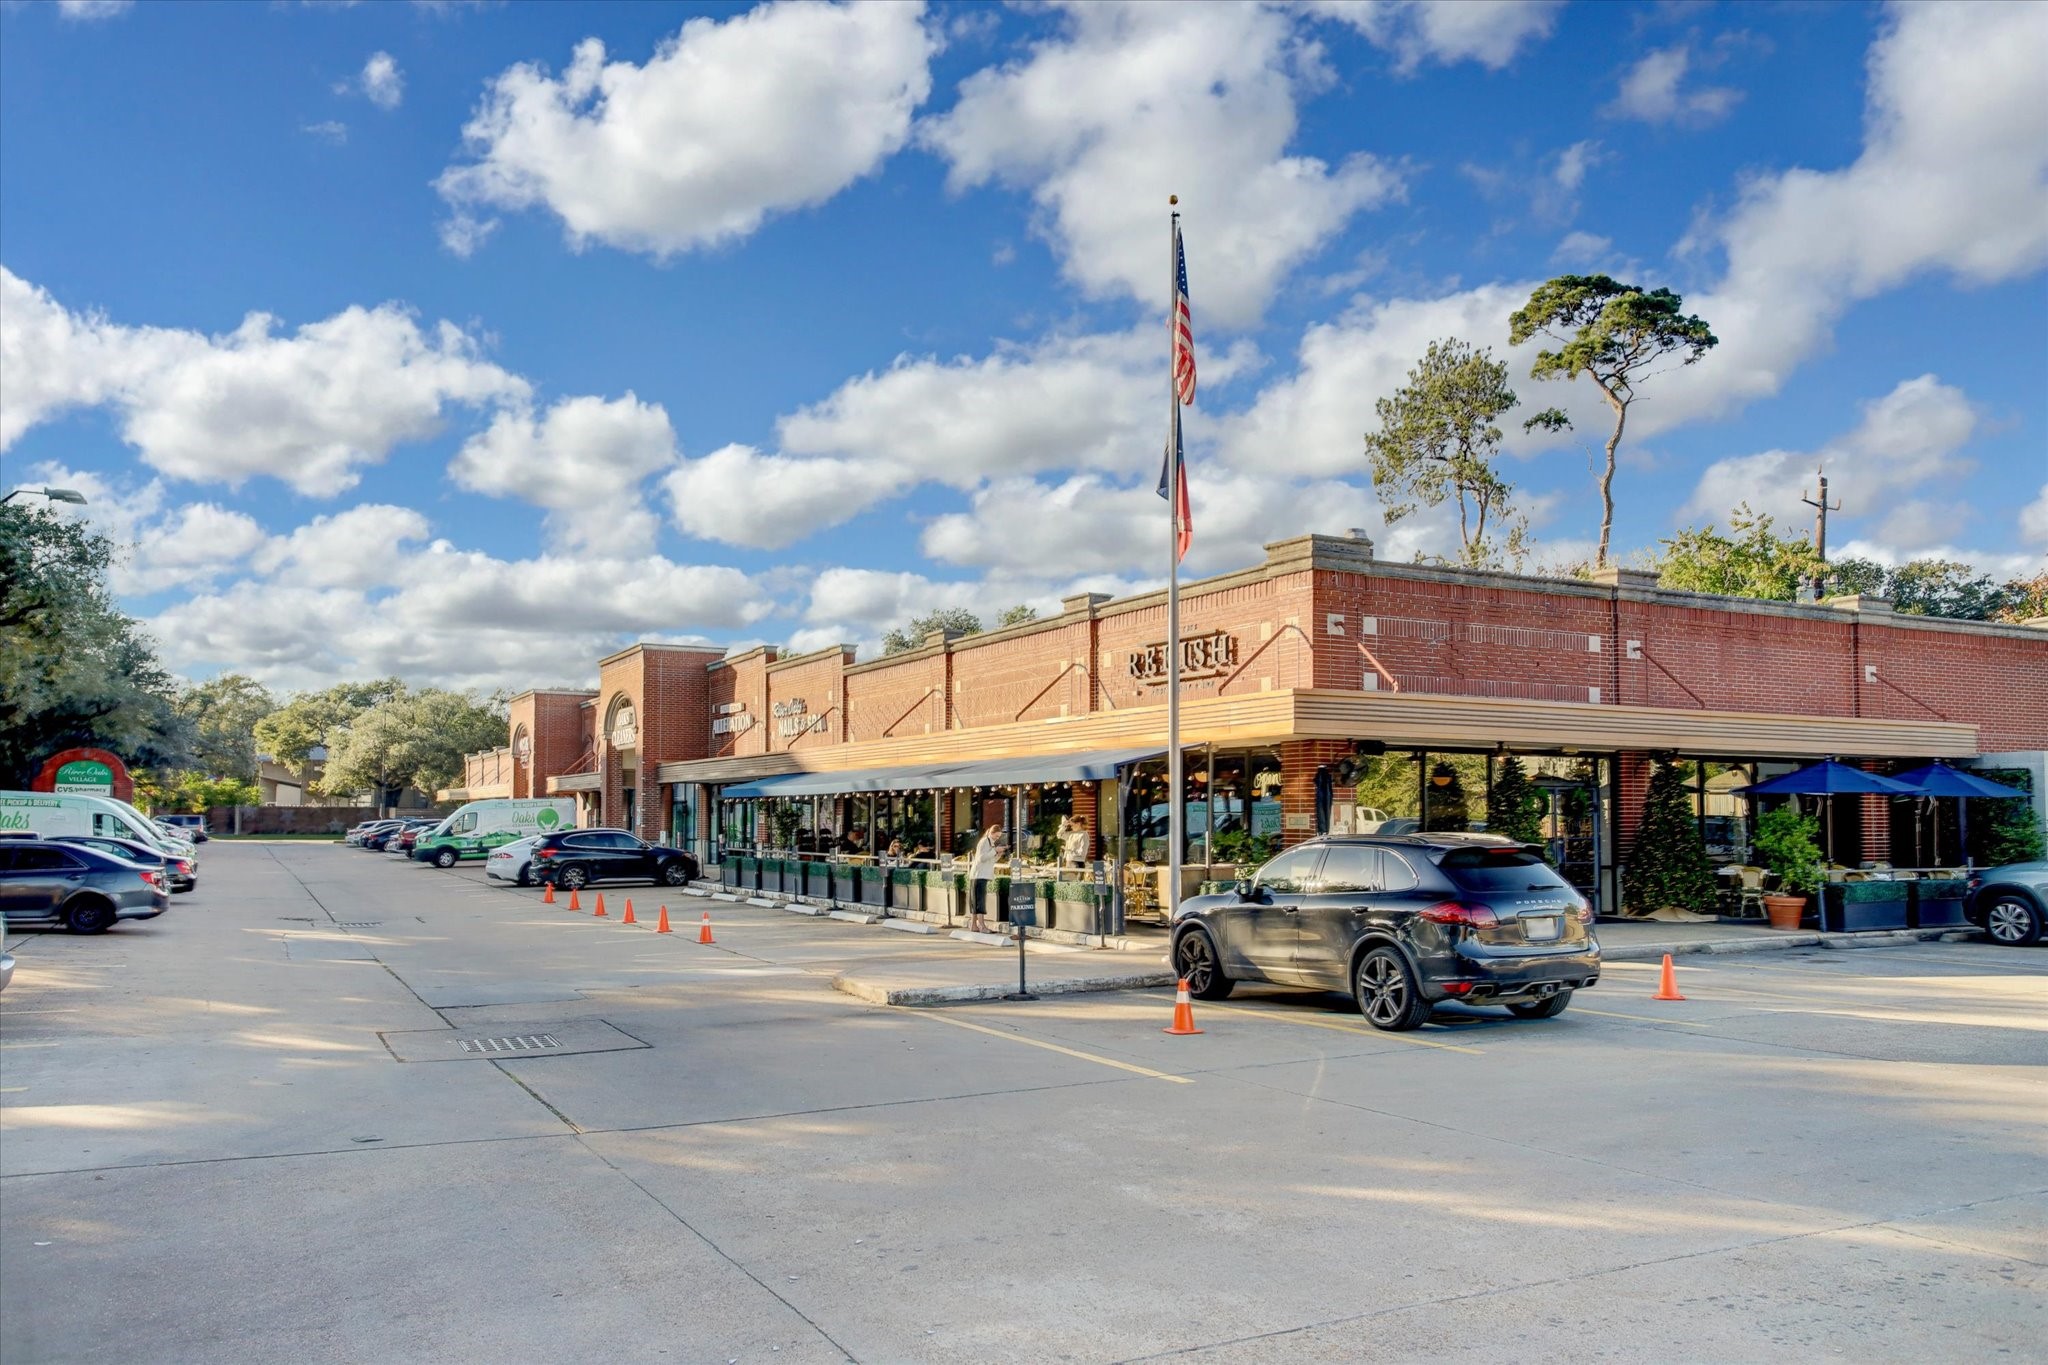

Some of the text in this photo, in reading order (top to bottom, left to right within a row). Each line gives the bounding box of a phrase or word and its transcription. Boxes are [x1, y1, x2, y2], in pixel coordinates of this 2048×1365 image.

[778, 717, 799, 737] NAILS
[0, 810, 30, 830] aks
[512, 811, 535, 824] Oaks
